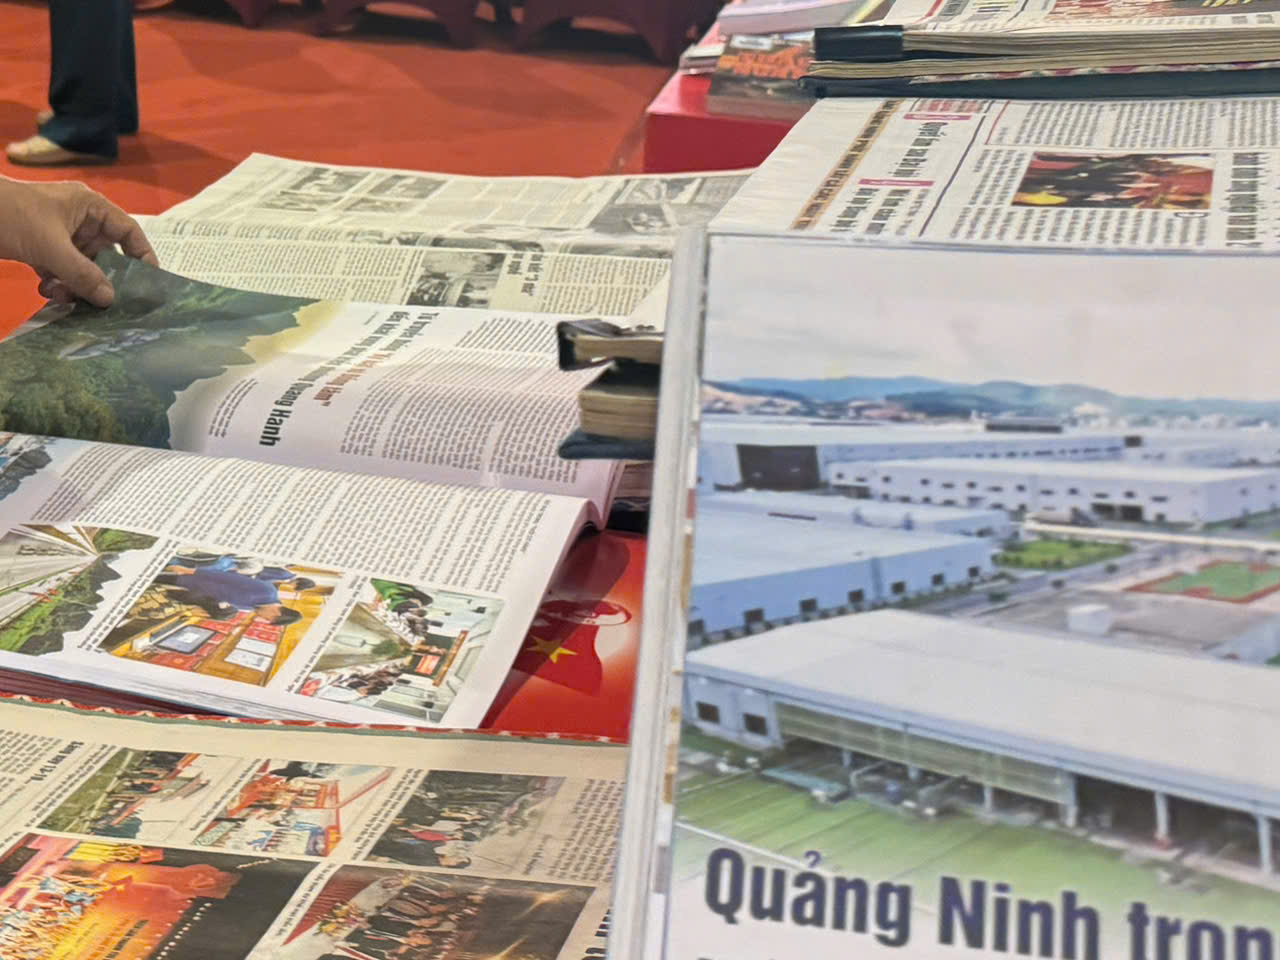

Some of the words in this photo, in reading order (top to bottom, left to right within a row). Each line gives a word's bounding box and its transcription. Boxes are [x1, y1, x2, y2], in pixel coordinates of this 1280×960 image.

[259, 408, 294, 447] Hanh
[704, 847, 912, 947] Quảng
[938, 875, 1100, 960] Ninh
